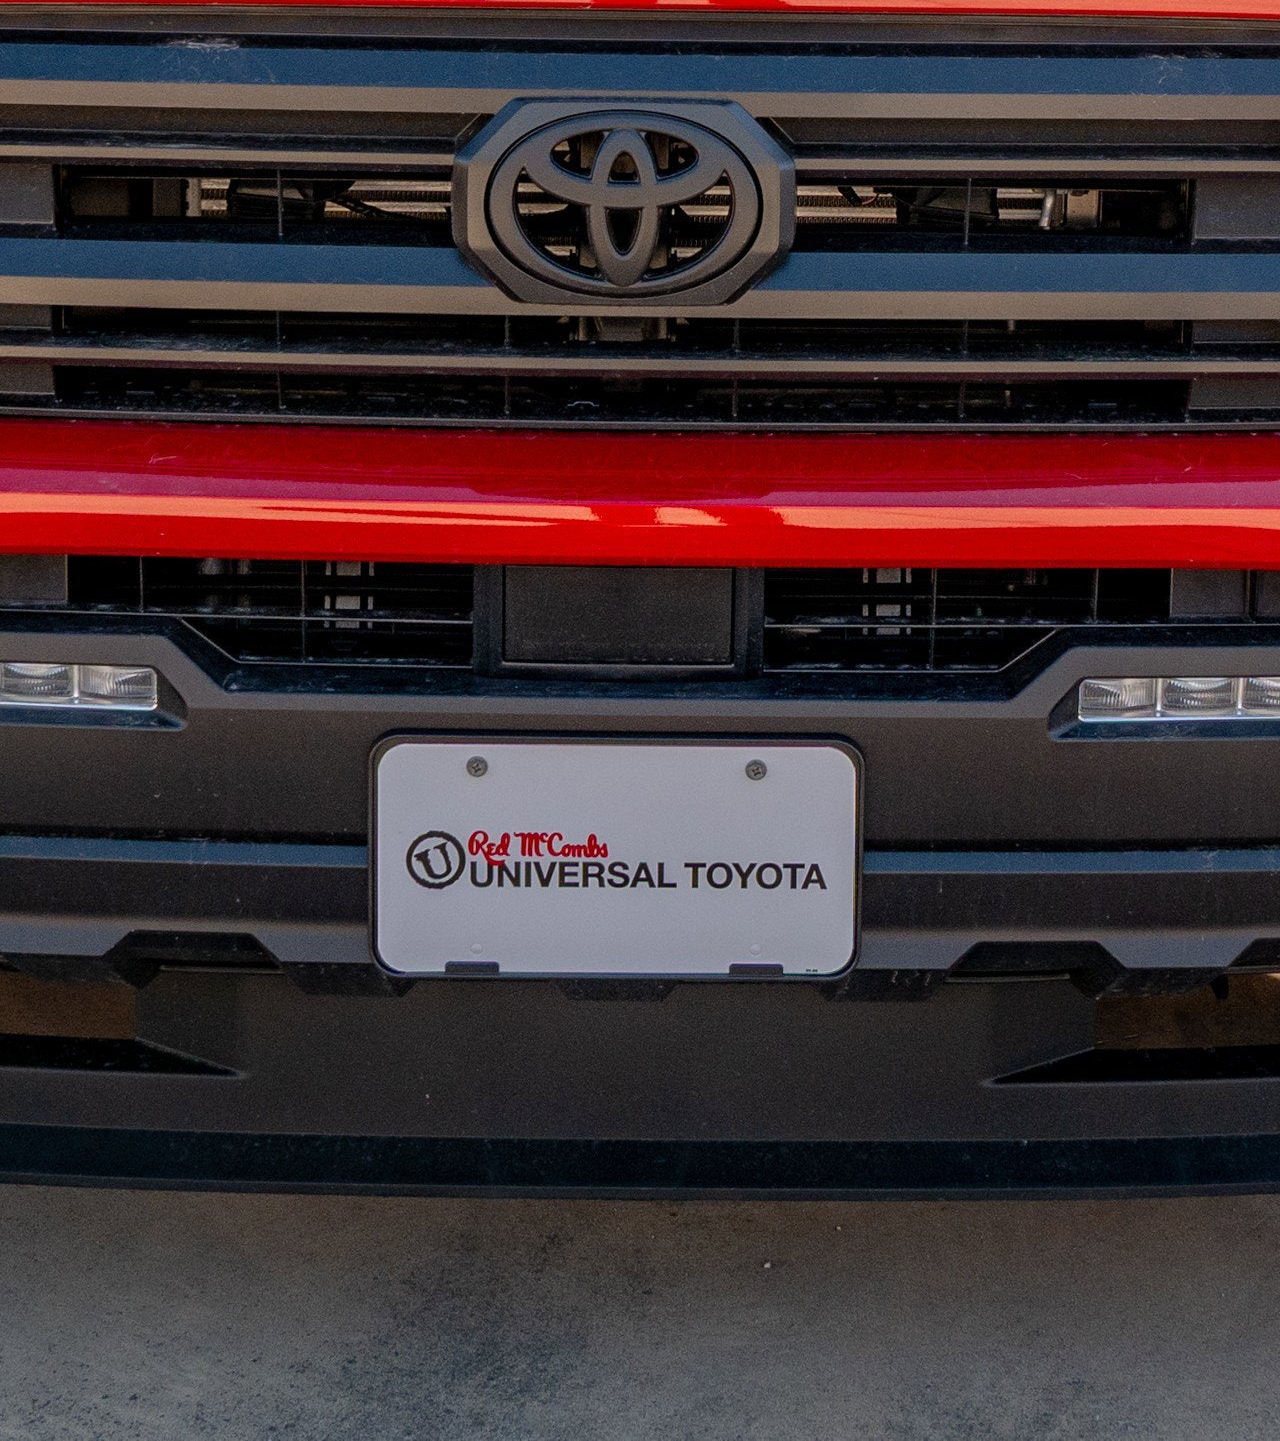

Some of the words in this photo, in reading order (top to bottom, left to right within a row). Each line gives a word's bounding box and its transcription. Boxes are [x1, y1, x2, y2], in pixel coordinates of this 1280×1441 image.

[468, 830, 511, 866] Red
[514, 831, 609, 858] McCombs
[470, 861, 677, 889] UNIVERSAL
[684, 862, 828, 890] TOYOTA
